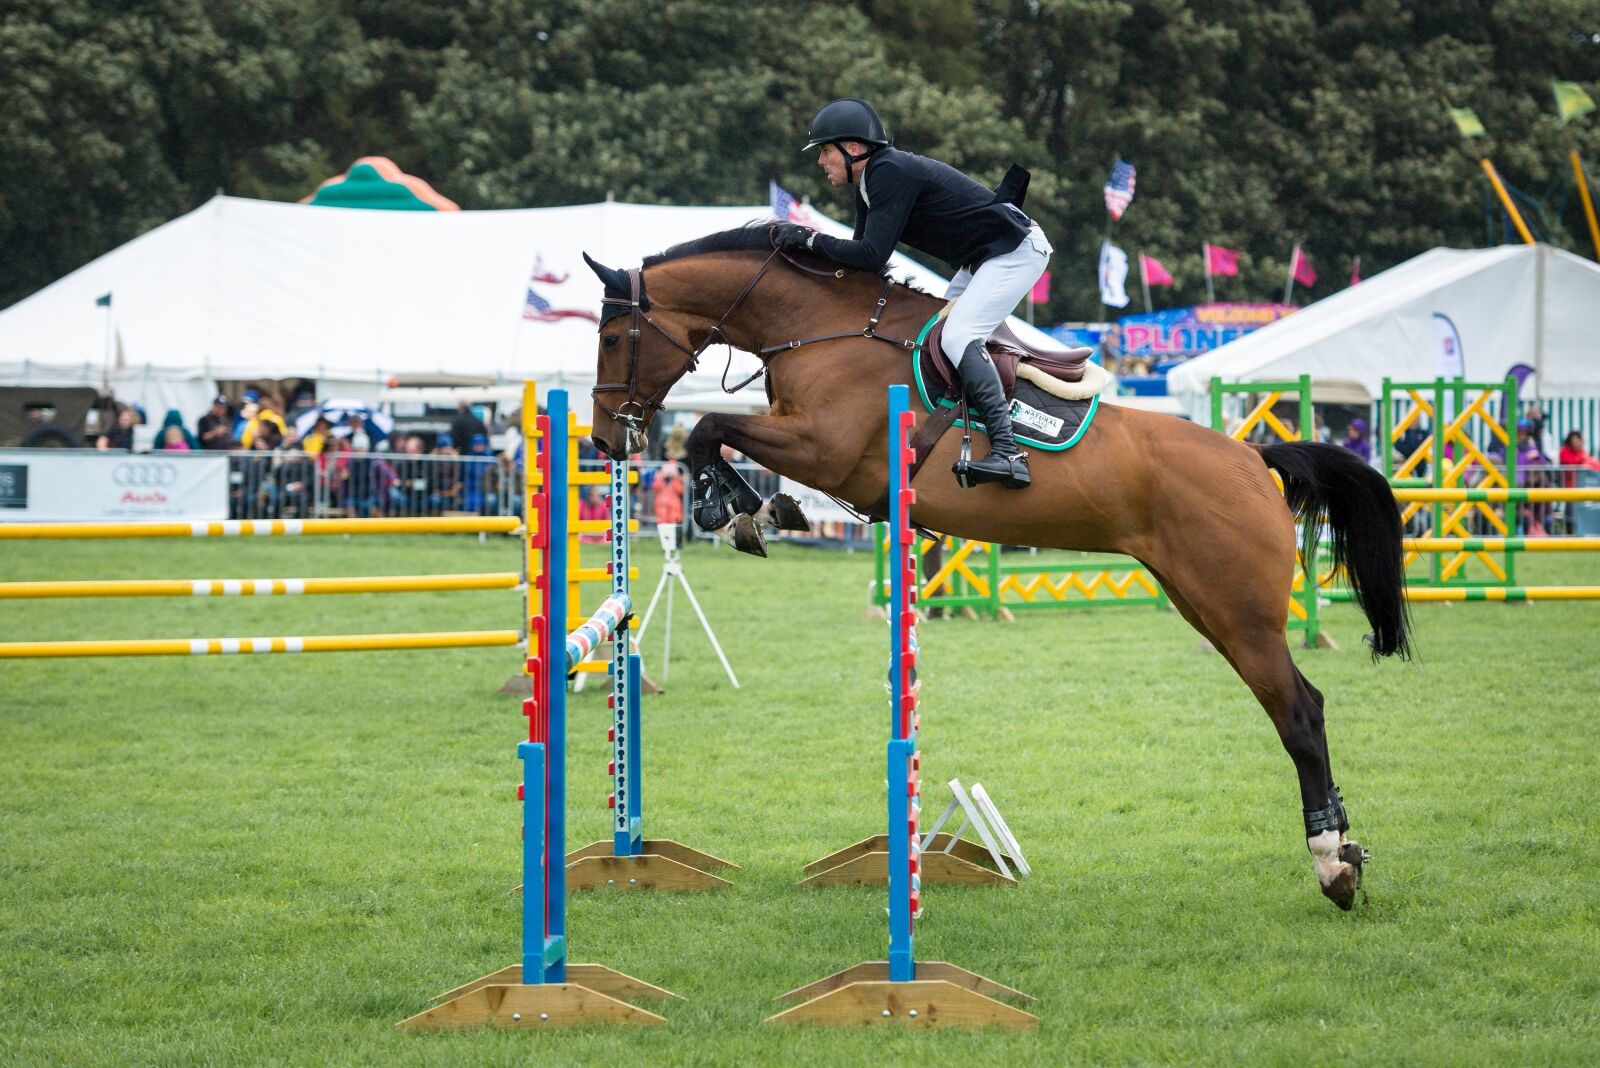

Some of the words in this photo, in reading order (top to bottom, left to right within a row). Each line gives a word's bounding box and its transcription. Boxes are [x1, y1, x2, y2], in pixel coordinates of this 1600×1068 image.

[1196, 307, 1276, 323] WELCOME
[1024, 409, 1057, 428] NATURAL
[121, 490, 168, 506] Audi
